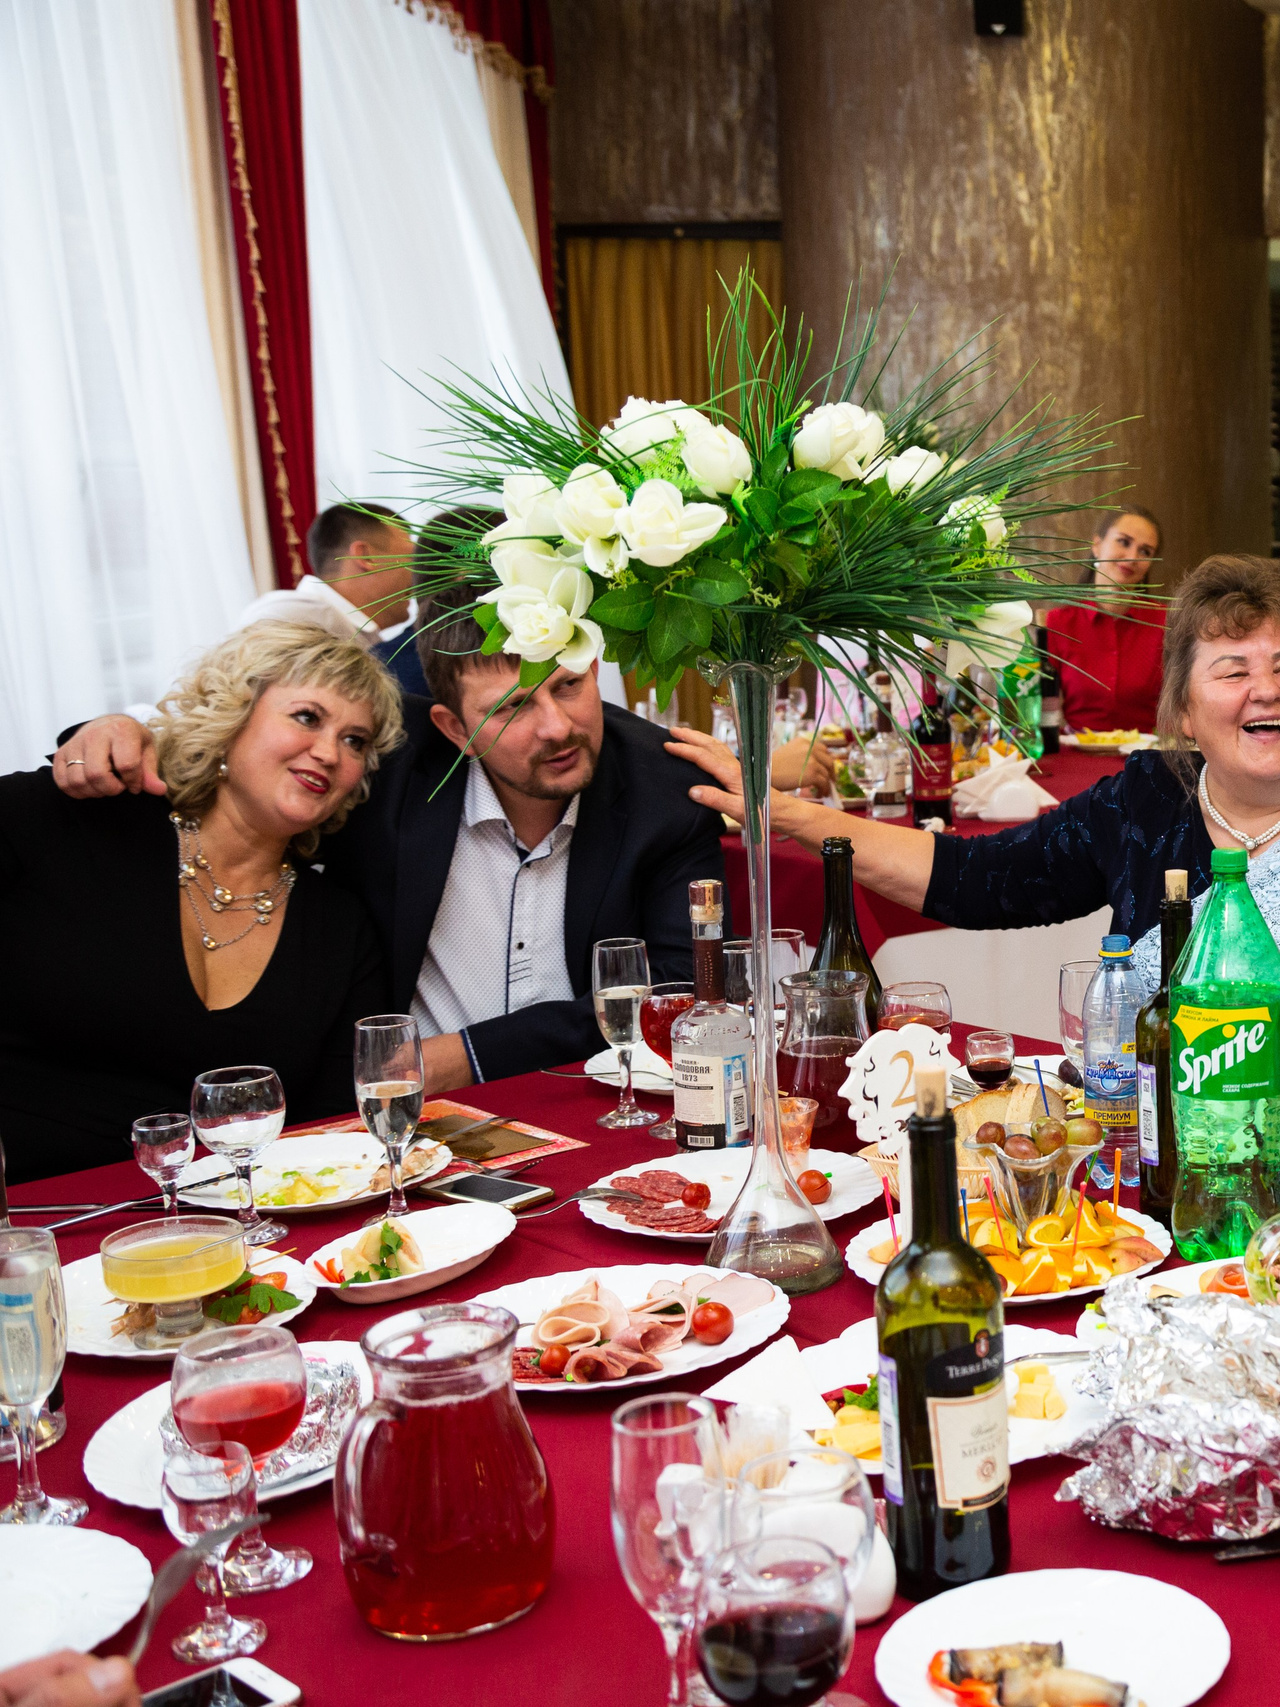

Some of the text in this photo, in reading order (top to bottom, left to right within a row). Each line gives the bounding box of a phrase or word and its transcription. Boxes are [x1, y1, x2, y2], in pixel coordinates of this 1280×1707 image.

[1177, 1022, 1267, 1095] Sprite
[681, 1073, 698, 1082] 1873
[889, 1050, 917, 1108] 2
[1093, 1111, 1131, 1121] ПРЕМИУМ
